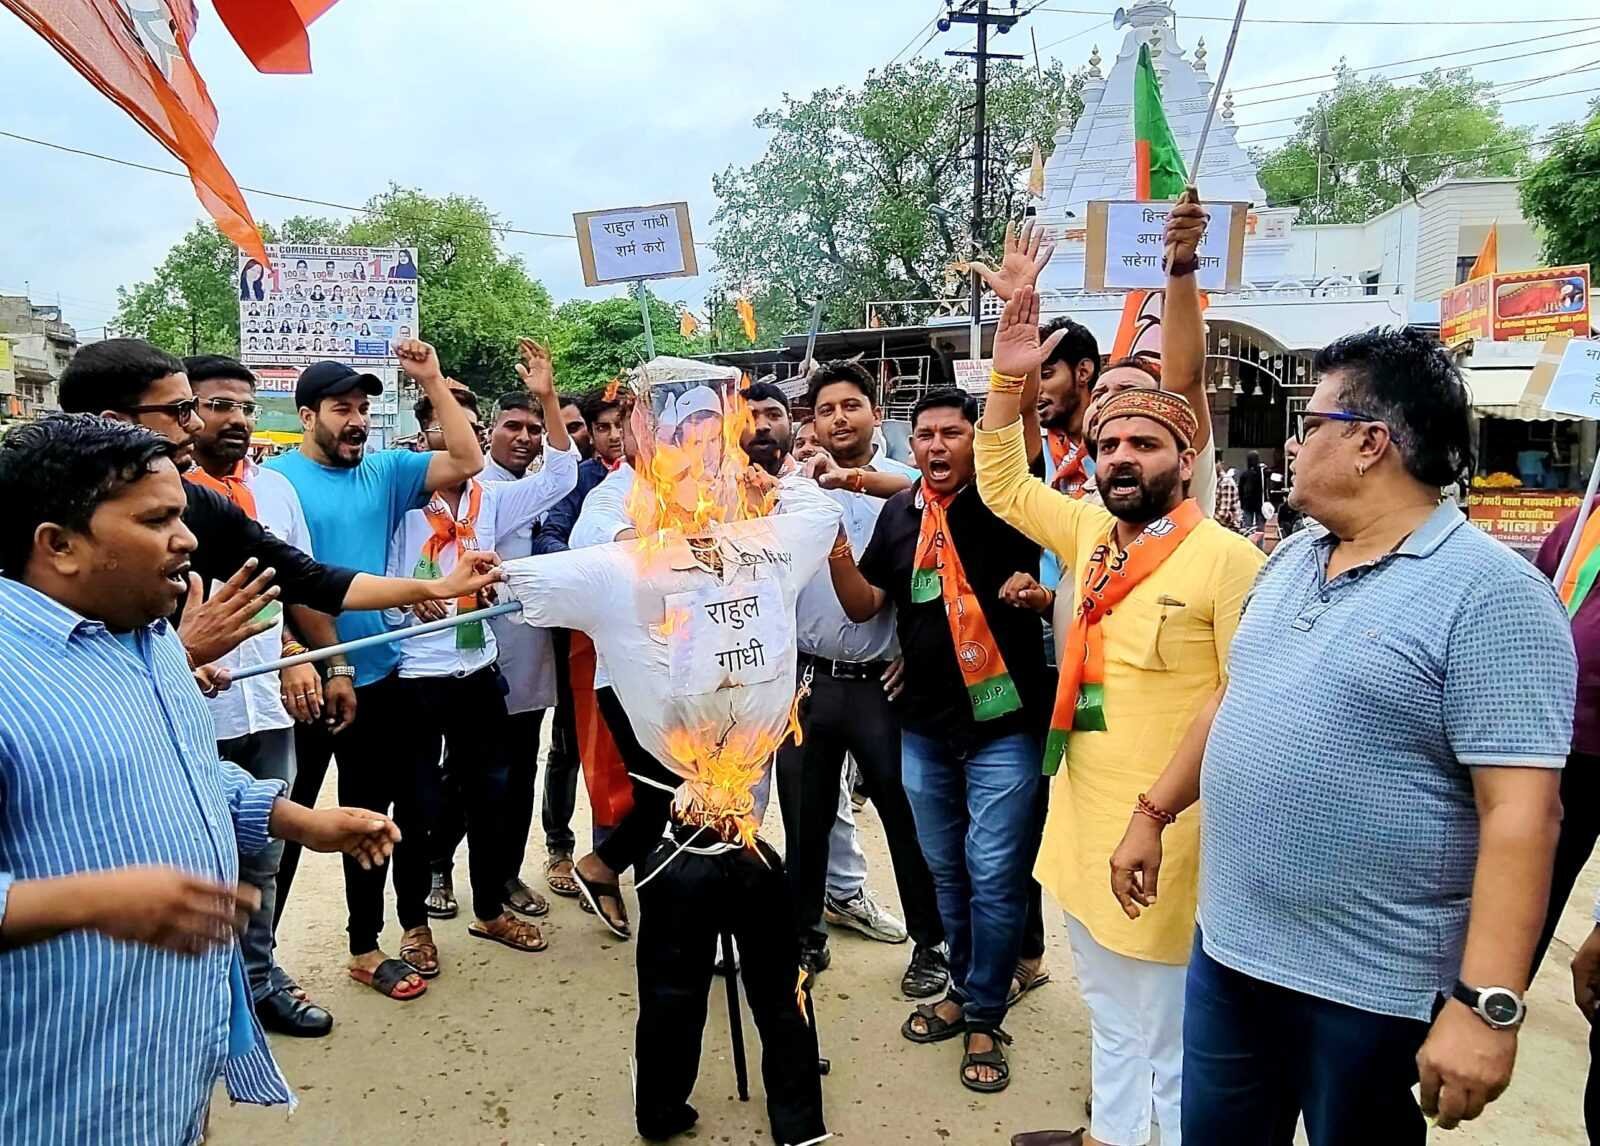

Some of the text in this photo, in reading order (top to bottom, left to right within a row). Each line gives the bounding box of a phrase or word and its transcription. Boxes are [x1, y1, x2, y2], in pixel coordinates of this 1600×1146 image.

[602, 213, 669, 237] राहुल गांधी
[280, 246, 328, 255] COMMERCE
[330, 247, 368, 256] CLASSES
[615, 237, 665, 257] शर्म करो
[1122, 252, 1157, 267] सहेगा
[704, 595, 760, 630] राहुल
[714, 637, 764, 672] गांधी
